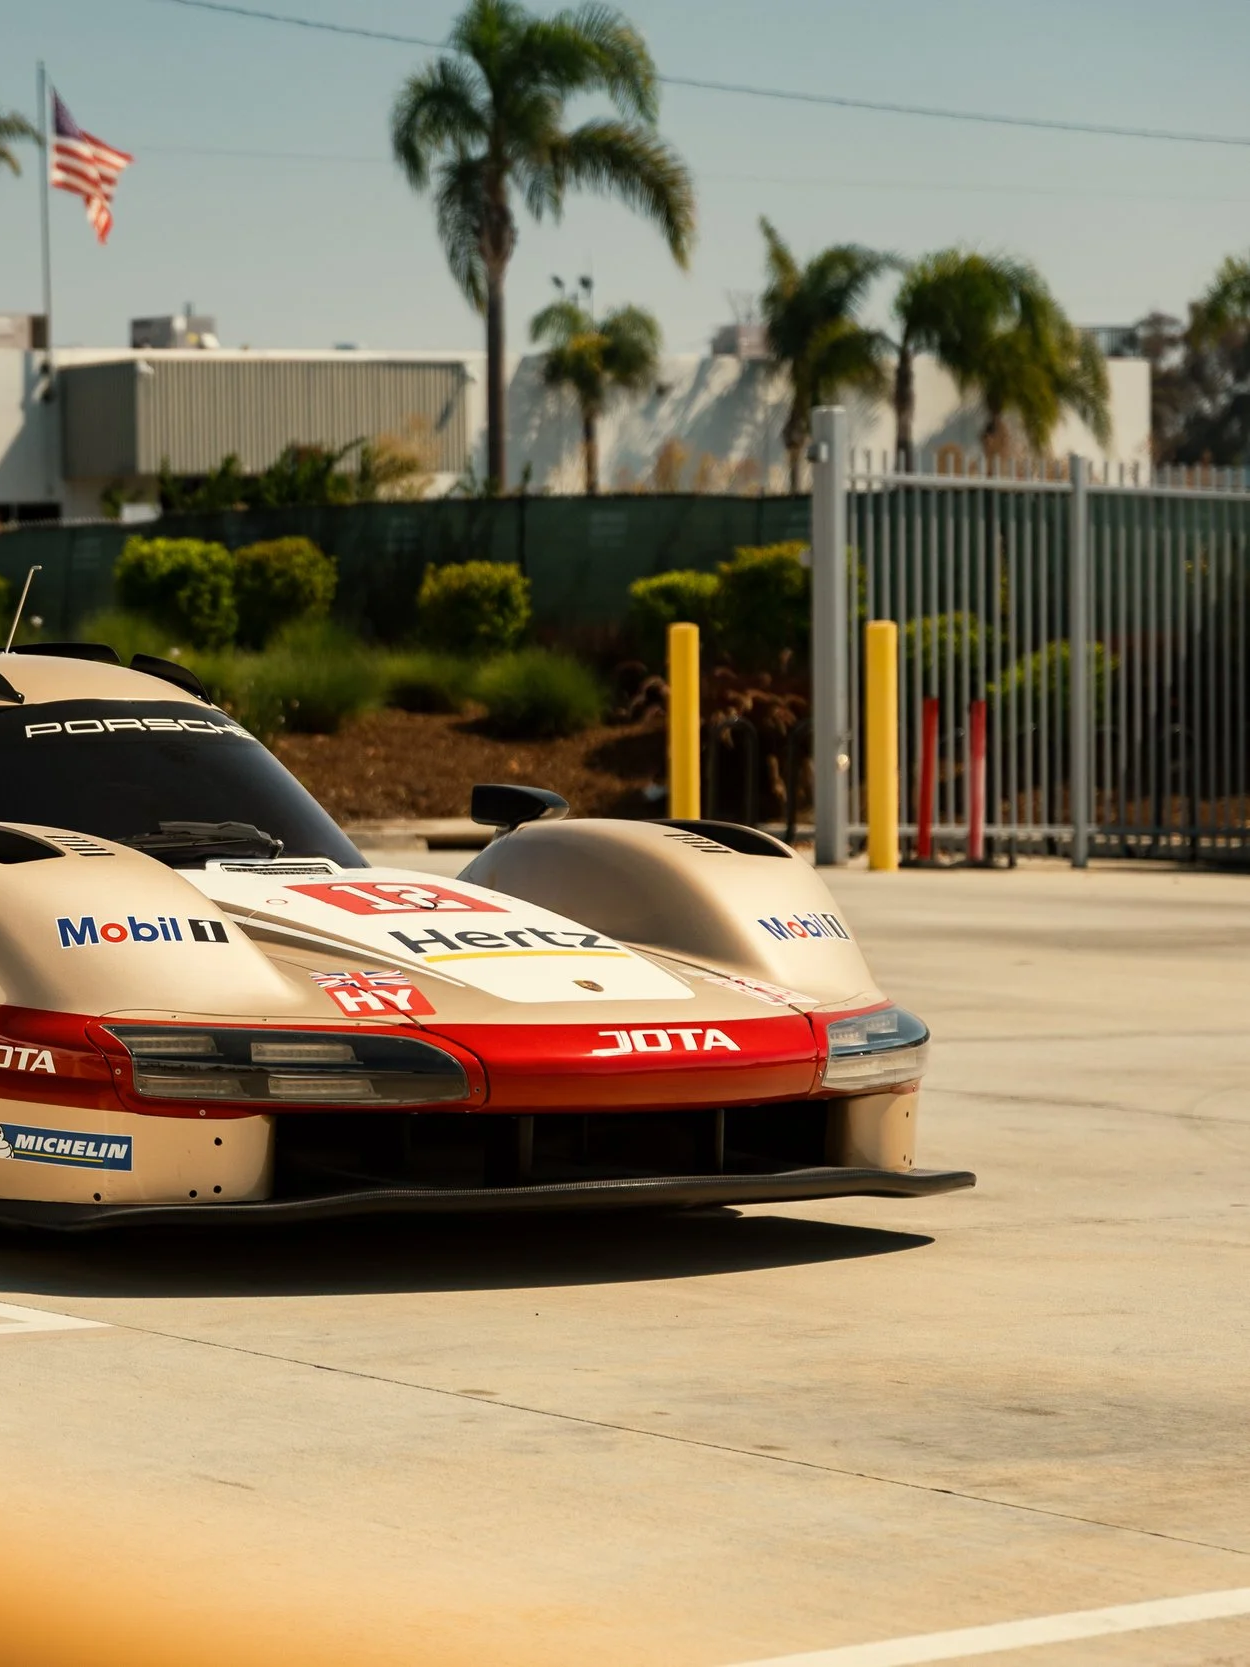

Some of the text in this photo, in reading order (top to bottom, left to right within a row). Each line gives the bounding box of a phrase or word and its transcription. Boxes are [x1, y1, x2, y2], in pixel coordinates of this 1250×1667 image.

[25, 718, 257, 739] PORSCHE
[329, 884, 475, 910] 12
[56, 915, 223, 949] Mobil 1
[387, 926, 621, 954] Hertz
[756, 912, 849, 941] Mobil 1
[334, 987, 414, 1013] HY
[591, 1029, 742, 1057] JOTA
[15, 1133, 128, 1160] MICHELIN
